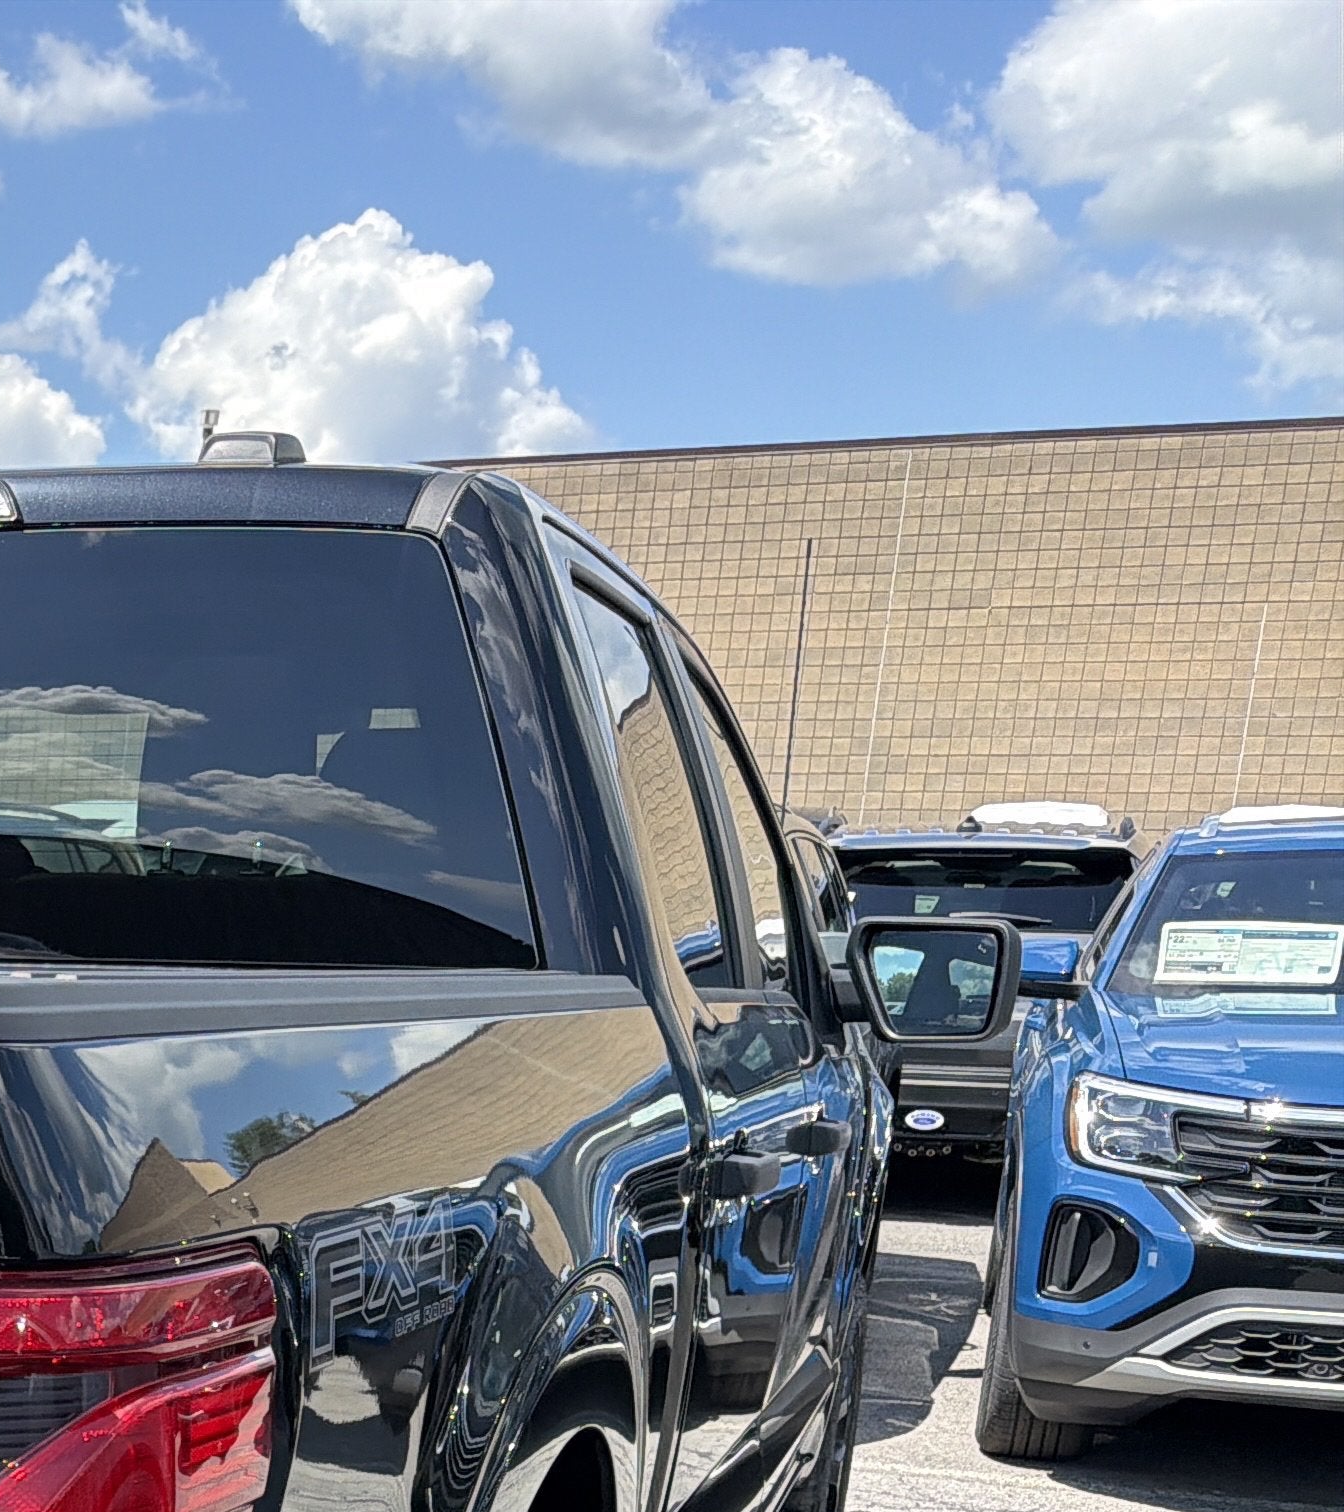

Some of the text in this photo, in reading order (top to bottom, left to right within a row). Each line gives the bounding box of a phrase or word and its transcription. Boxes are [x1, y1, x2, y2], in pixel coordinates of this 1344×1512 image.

[309, 1192, 457, 1374] FX4
[395, 1297, 456, 1337] OFF ROAD
